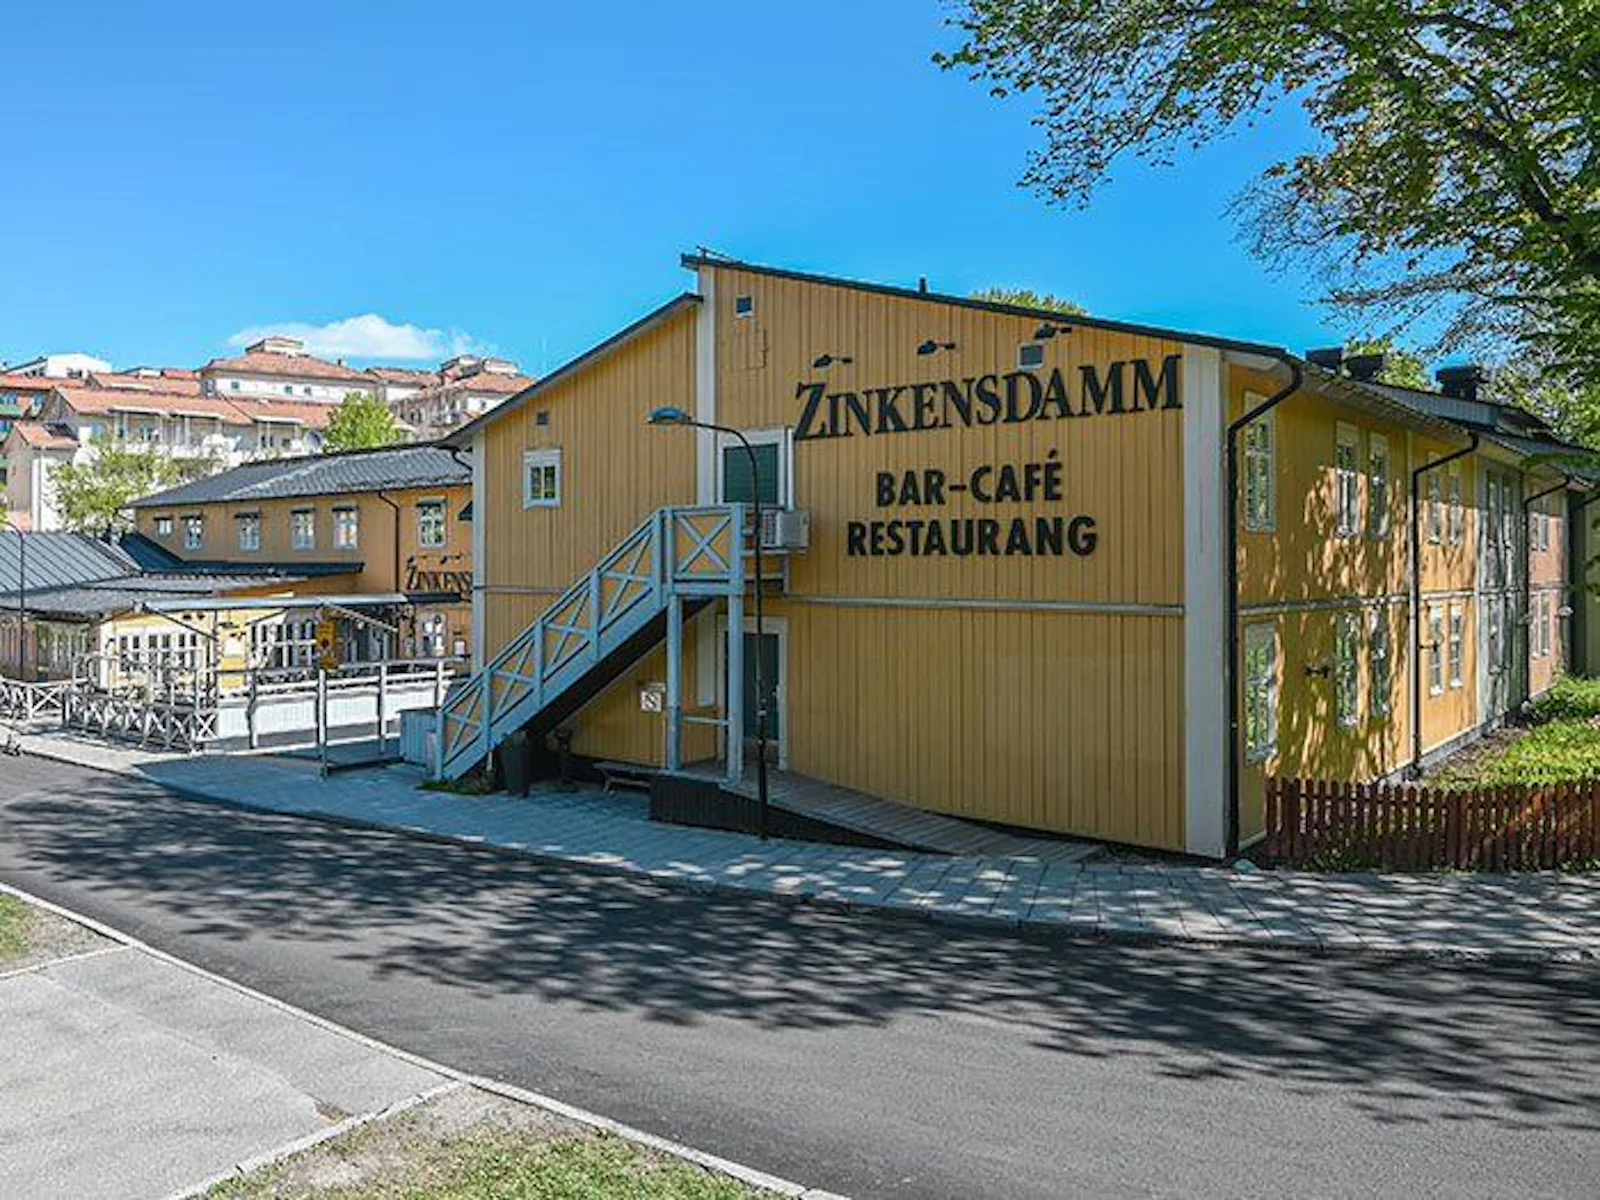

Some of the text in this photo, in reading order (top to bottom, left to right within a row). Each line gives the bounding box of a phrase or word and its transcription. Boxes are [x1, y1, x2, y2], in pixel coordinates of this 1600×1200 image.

[794, 354, 1183, 441] ZINKENSDAMM
[876, 449, 1063, 507] BAR-CAFÉ
[847, 516, 1098, 556] RESTAURANG
